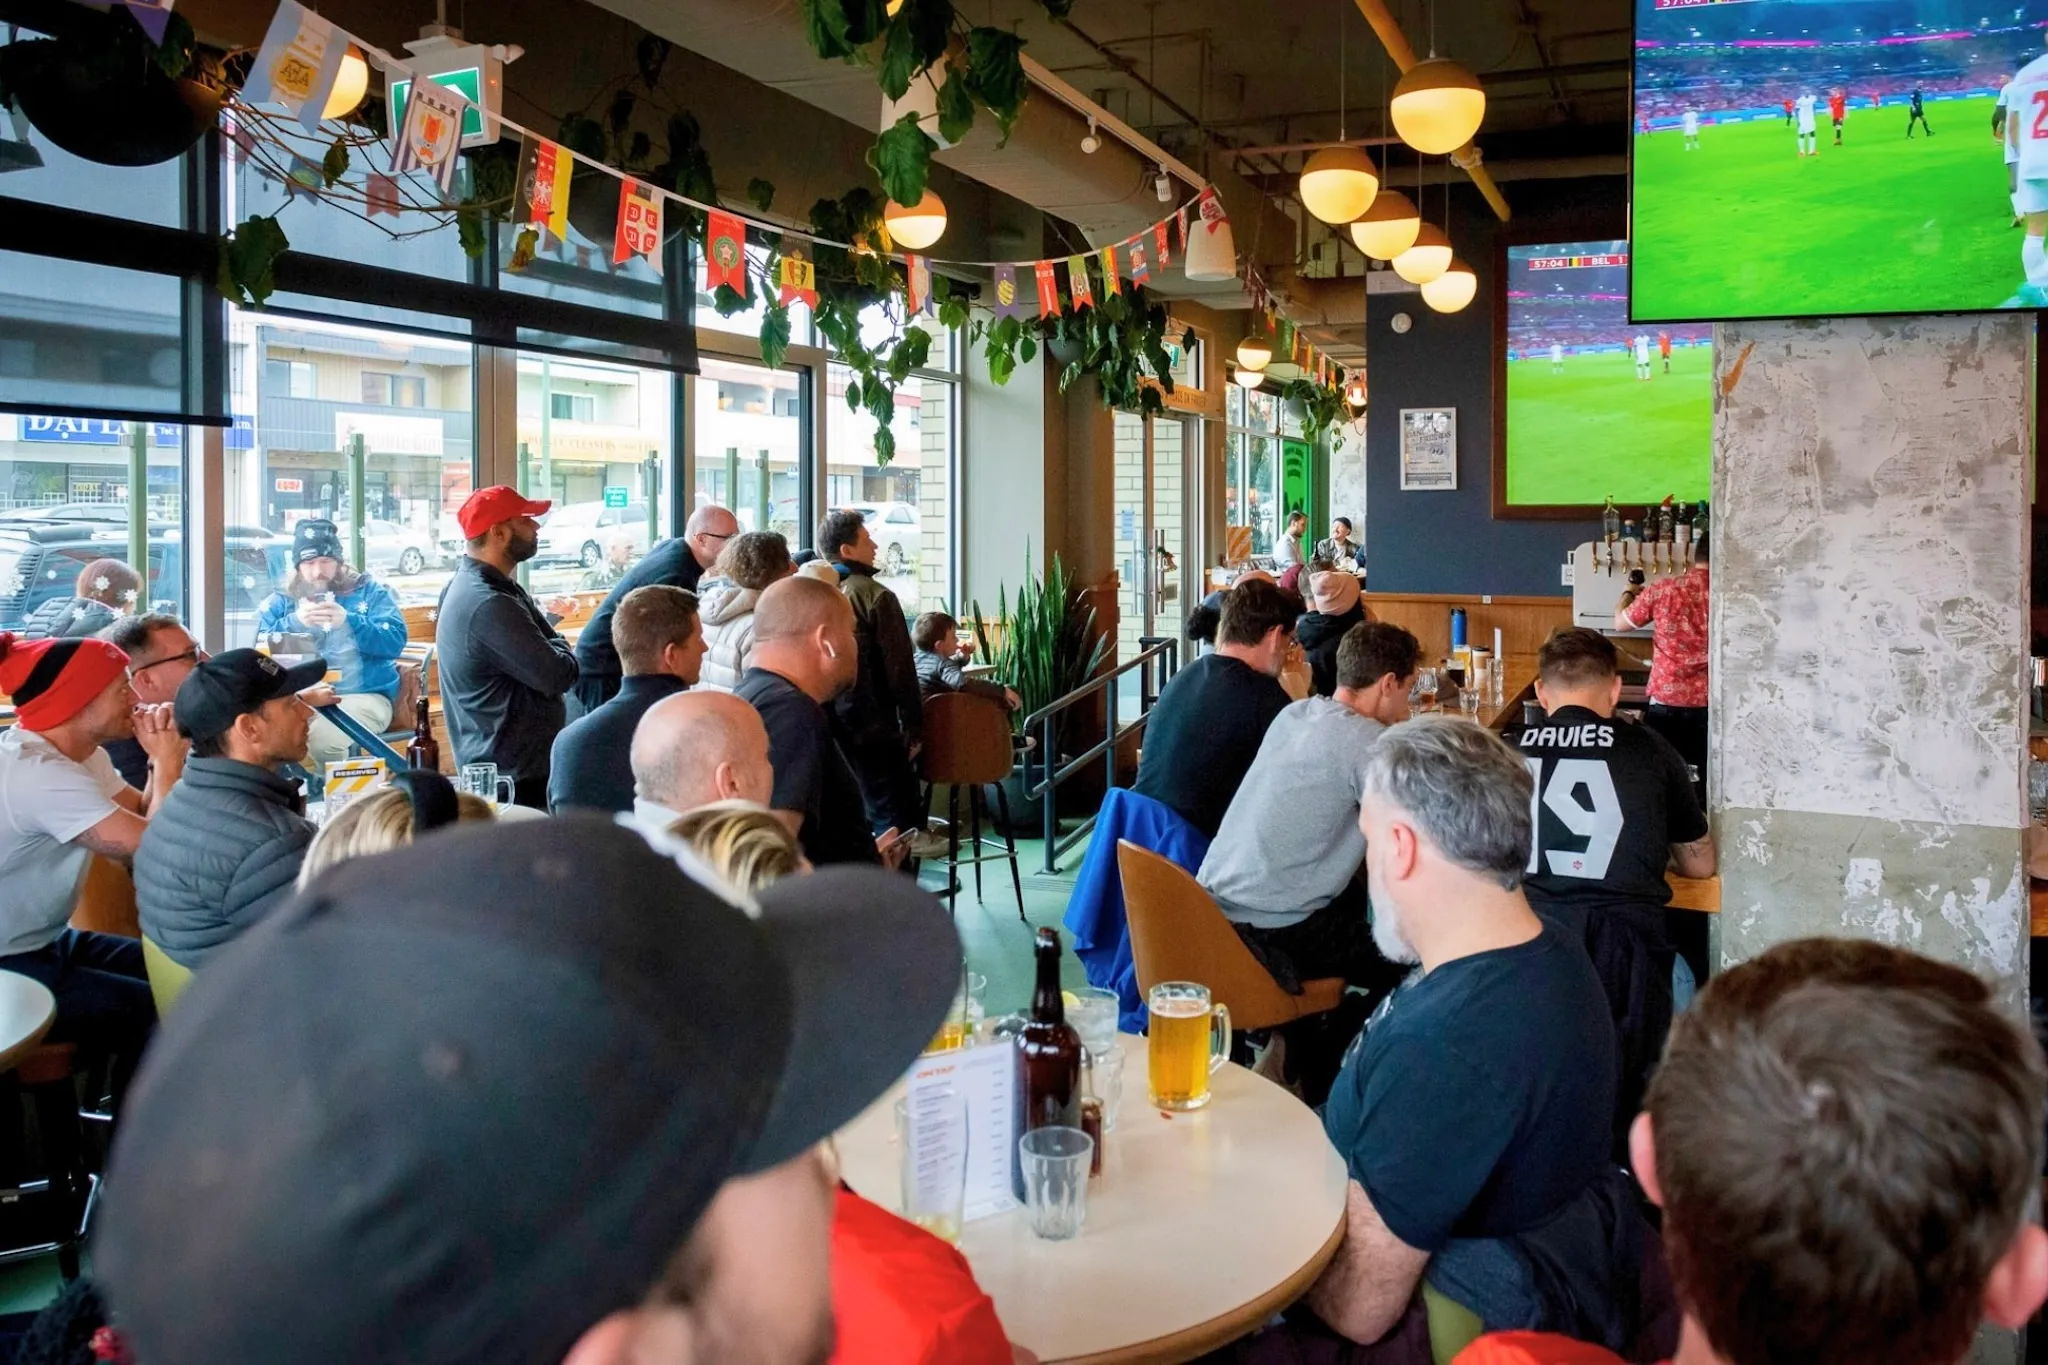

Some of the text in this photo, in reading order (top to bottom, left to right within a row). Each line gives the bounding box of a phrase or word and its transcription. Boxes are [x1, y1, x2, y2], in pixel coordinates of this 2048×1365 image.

[1534, 259, 1563, 268] 57:04
[1591, 256, 1610, 265] BEL
[1520, 724, 1614, 748] DAVIES
[335, 769, 378, 777] RESERVED
